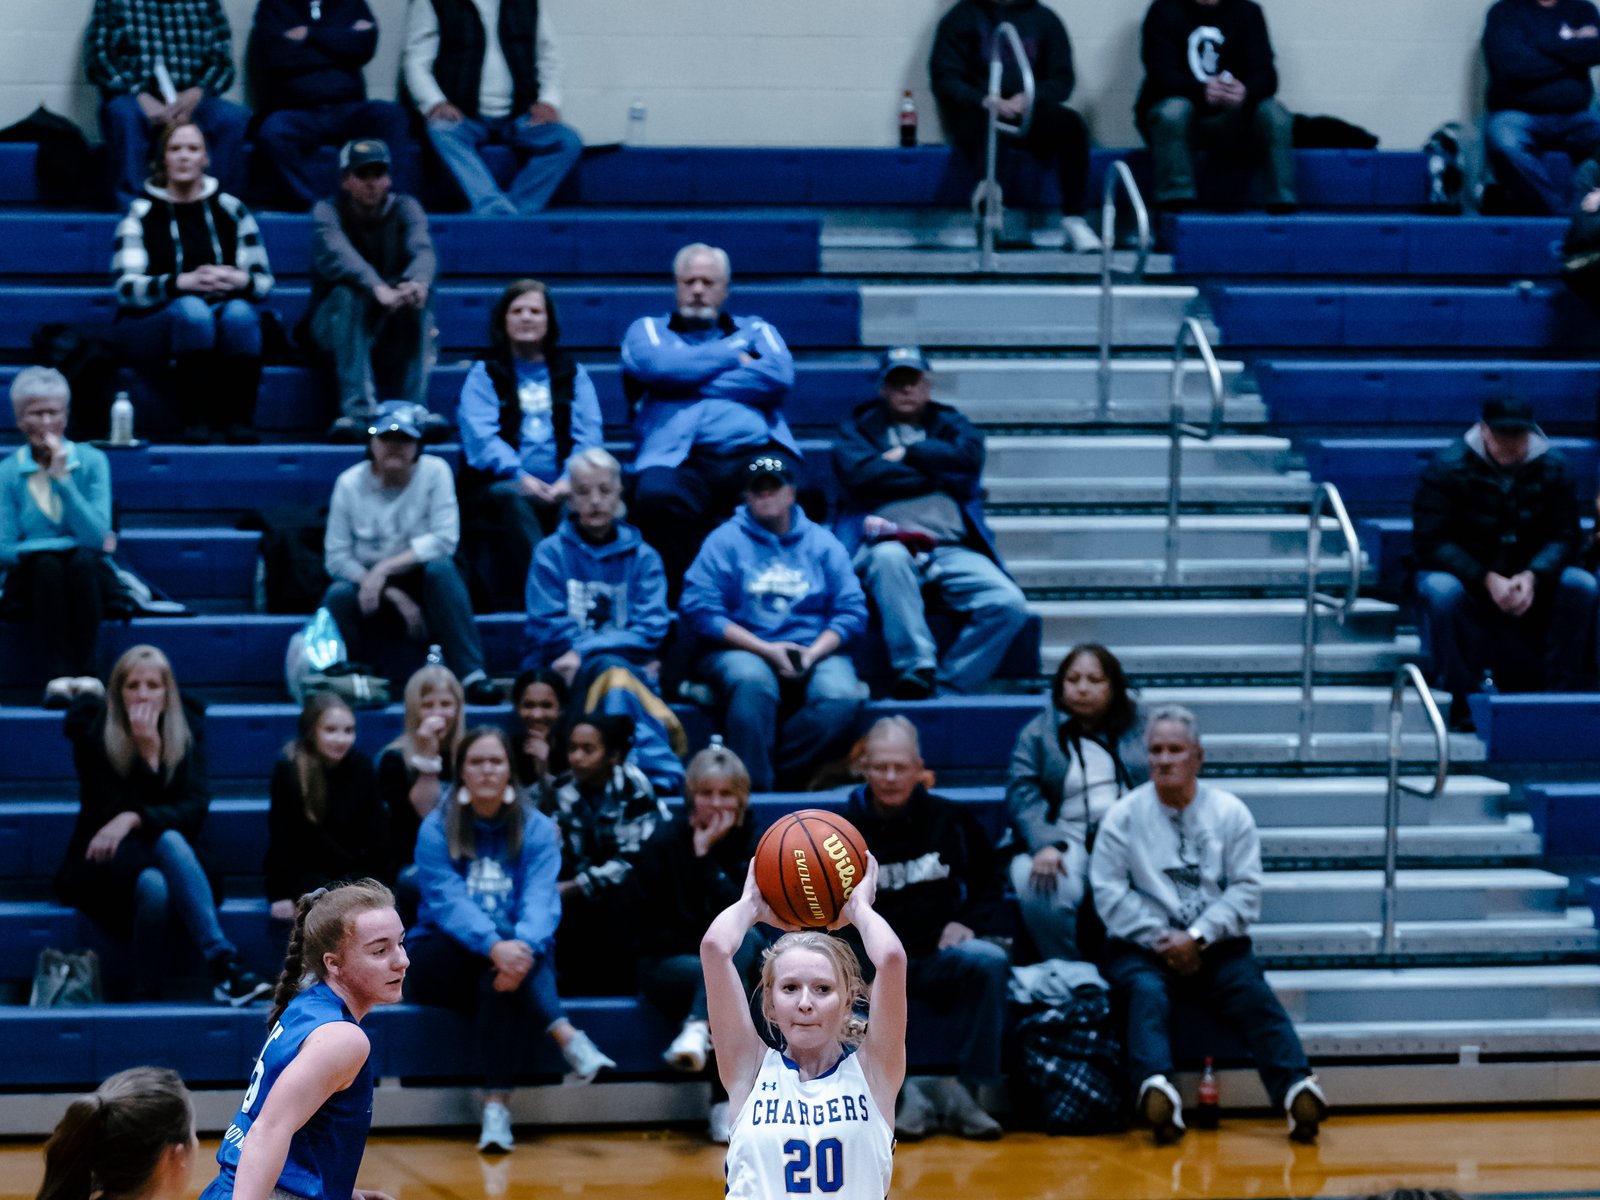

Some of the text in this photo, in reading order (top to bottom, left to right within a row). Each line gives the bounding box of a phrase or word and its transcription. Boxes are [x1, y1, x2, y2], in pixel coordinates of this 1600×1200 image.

[793, 849, 826, 919] EVOLUTION
[823, 833, 856, 900] Wilso
[752, 1094, 869, 1127] CHARGERS
[783, 1136, 845, 1195] 20
